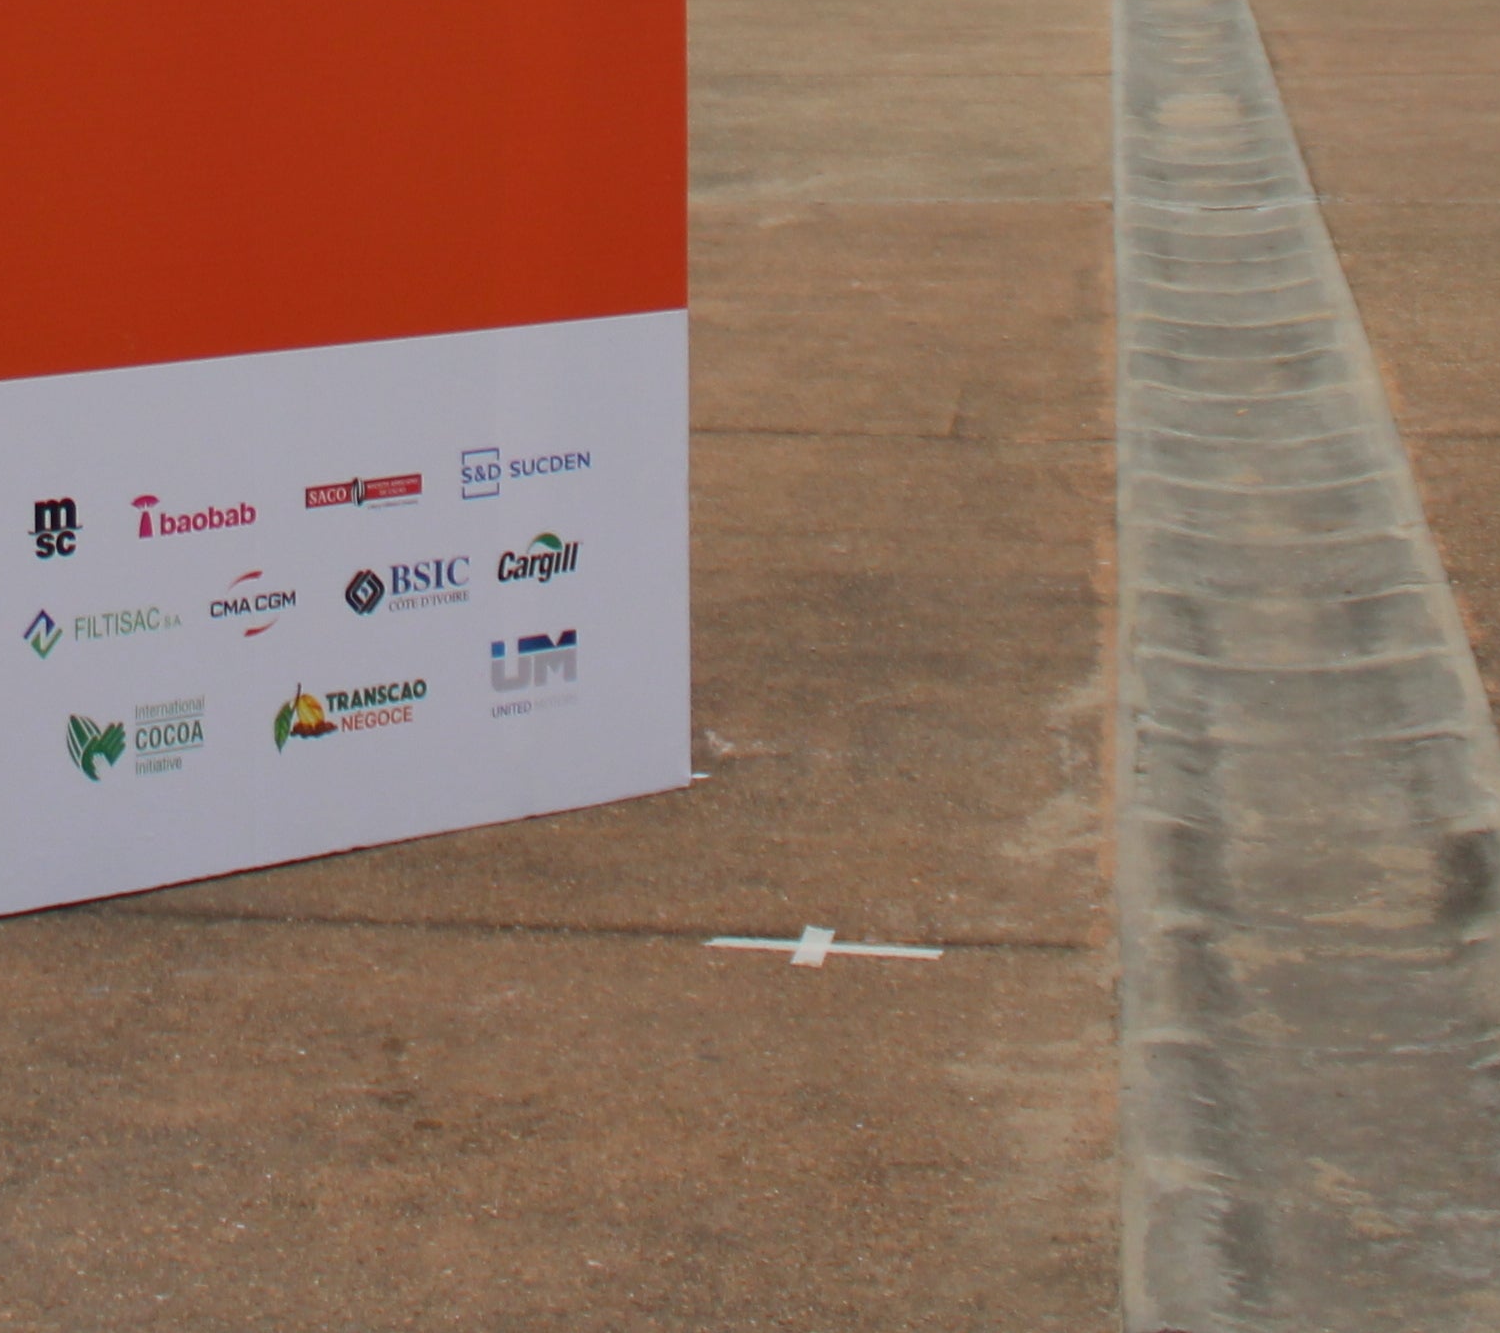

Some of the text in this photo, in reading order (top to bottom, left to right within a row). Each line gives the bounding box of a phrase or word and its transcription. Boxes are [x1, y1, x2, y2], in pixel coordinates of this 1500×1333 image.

[461, 452, 592, 484] S&D SUCDEN
[308, 486, 348, 506] SACO
[160, 502, 257, 536] baobab
[390, 555, 470, 595] BSIC
[498, 541, 580, 584] Cargill
[210, 590, 297, 618] CMA CGM
[420, 590, 470, 608] D'IVOIRE
[74, 606, 161, 642] FILTISAC
[491, 629, 578, 693] UM
[135, 694, 205, 720] International
[326, 679, 428, 713] TRANSCAO
[491, 699, 533, 718] UNITED
[342, 705, 414, 733] NÉGOCE
[135, 720, 204, 751] COCOA
[135, 757, 183, 776] Initiative
